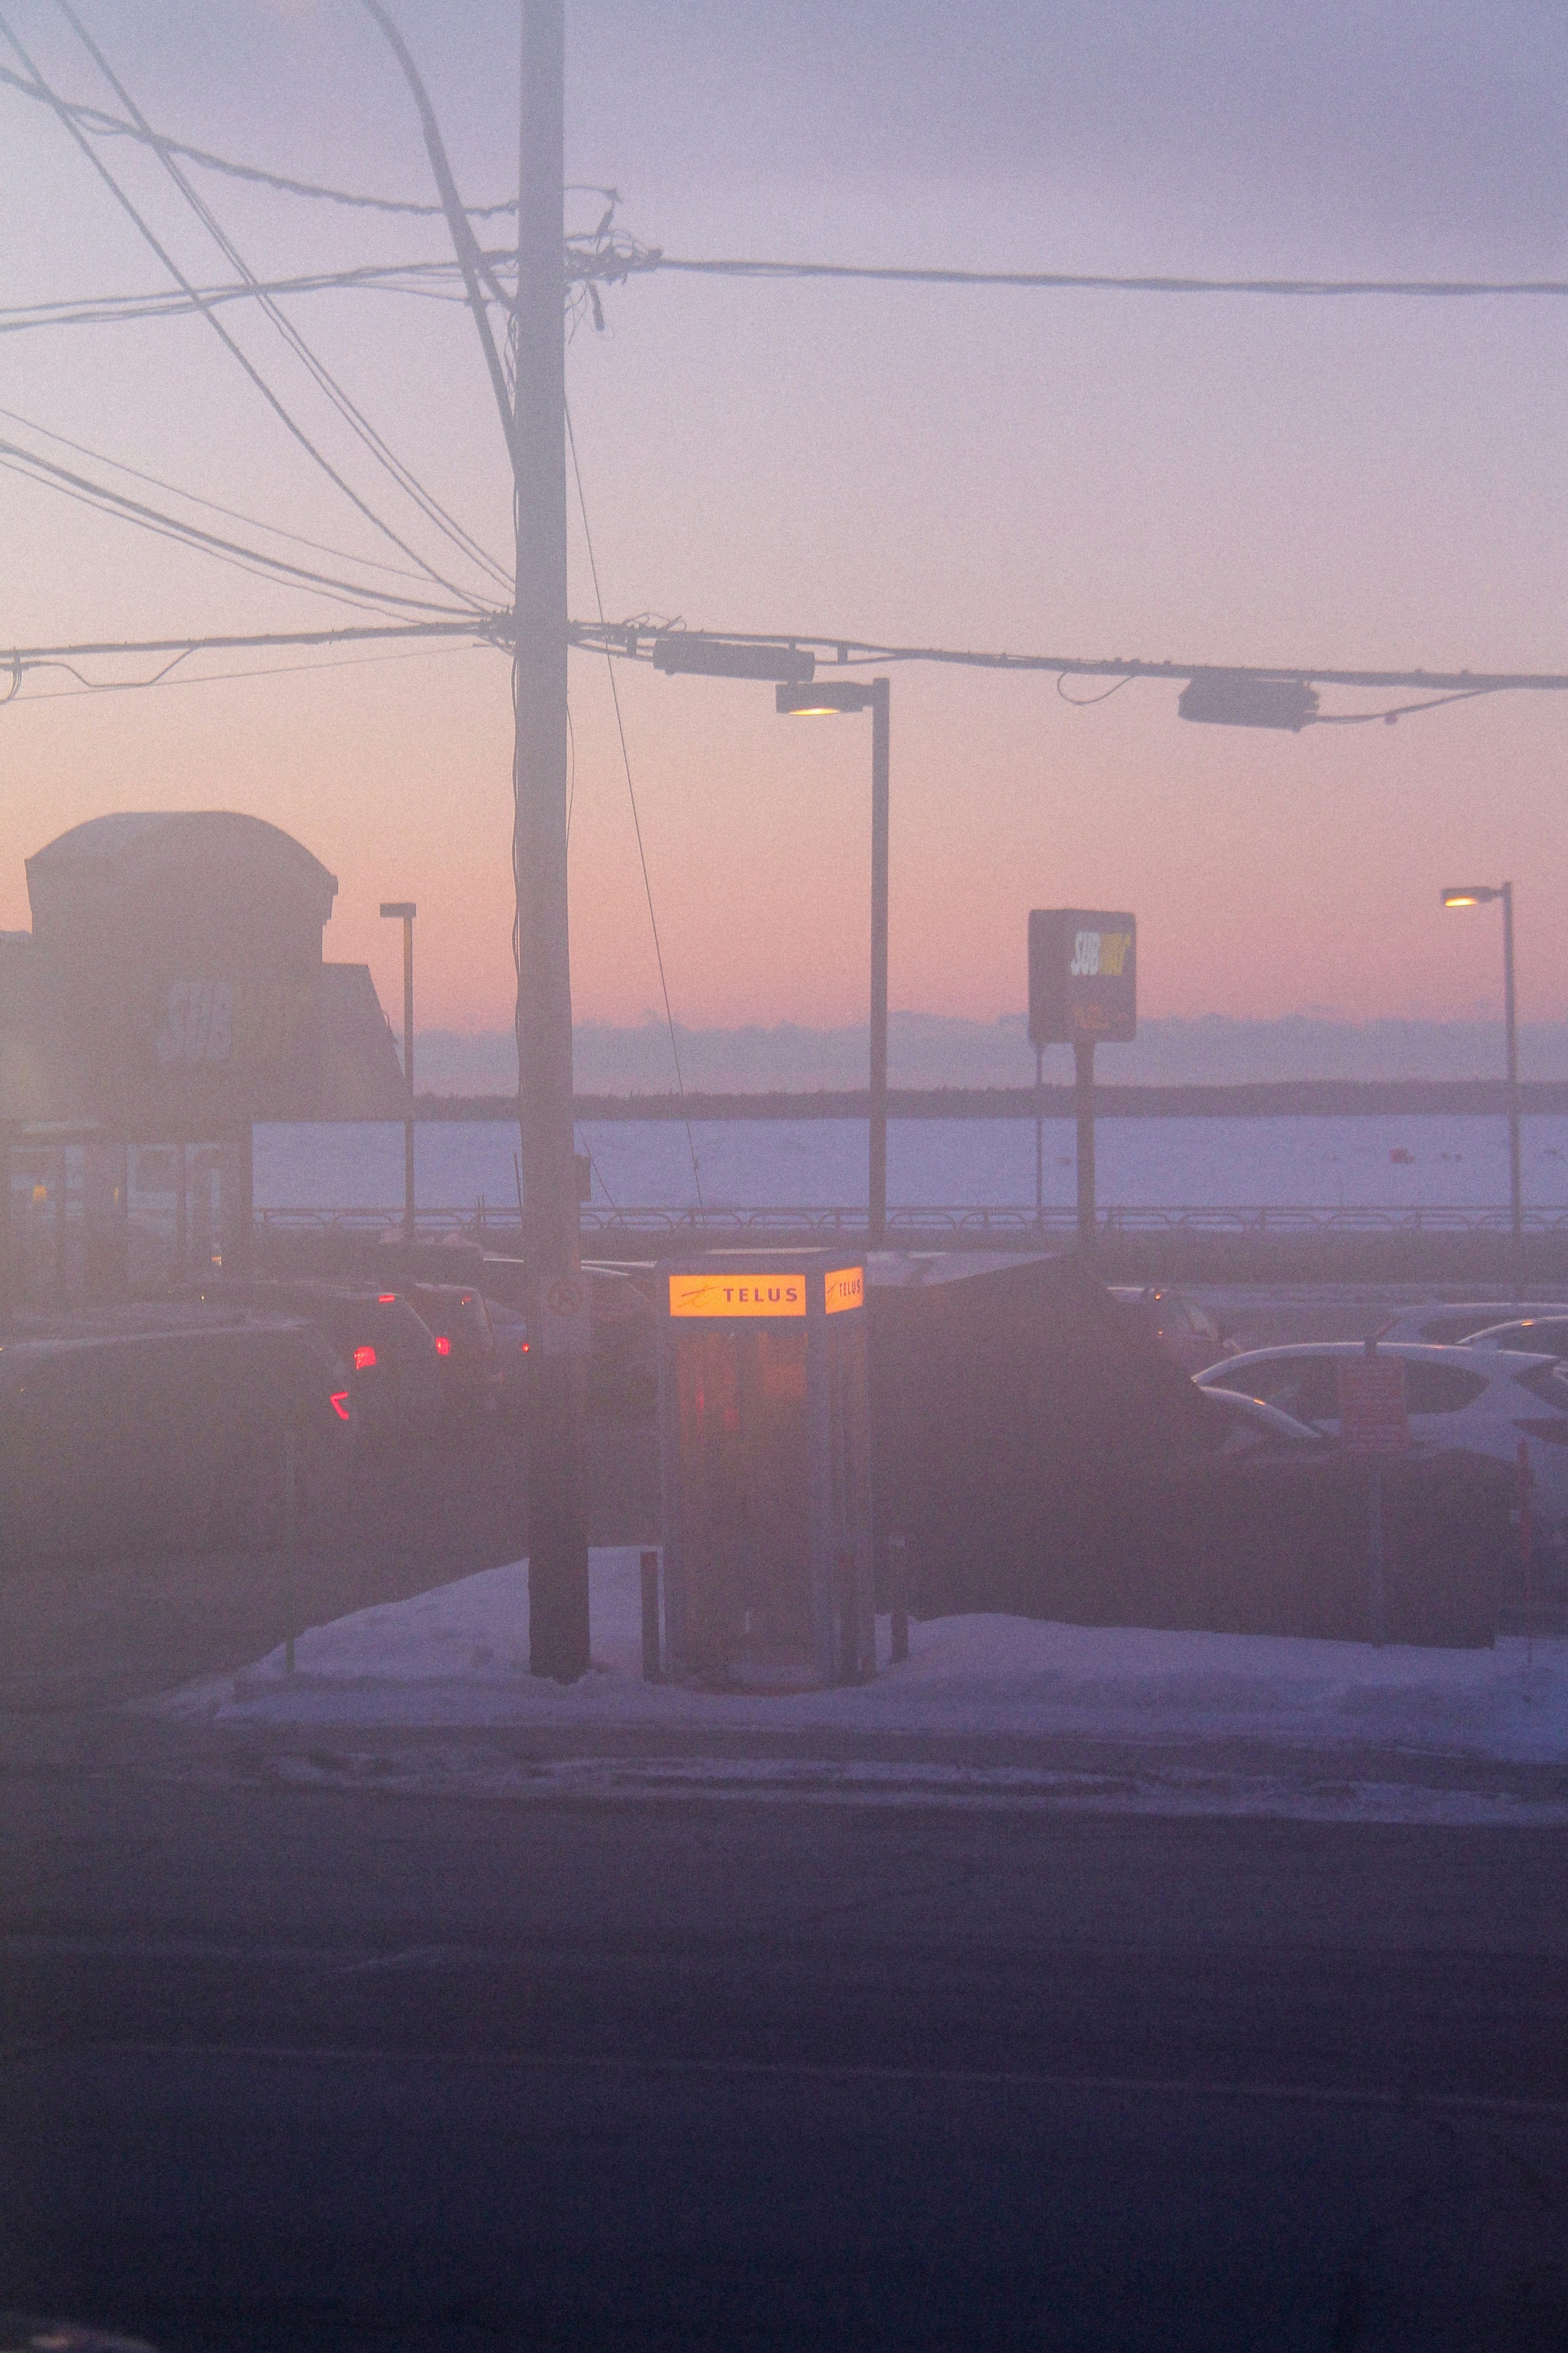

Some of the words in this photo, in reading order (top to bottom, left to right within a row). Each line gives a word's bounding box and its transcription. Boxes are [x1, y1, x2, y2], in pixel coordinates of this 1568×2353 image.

[1070, 931, 1130, 977] SUBY
[723, 1288, 798, 1302] TELUS
[839, 1278, 861, 1298] TELUS
